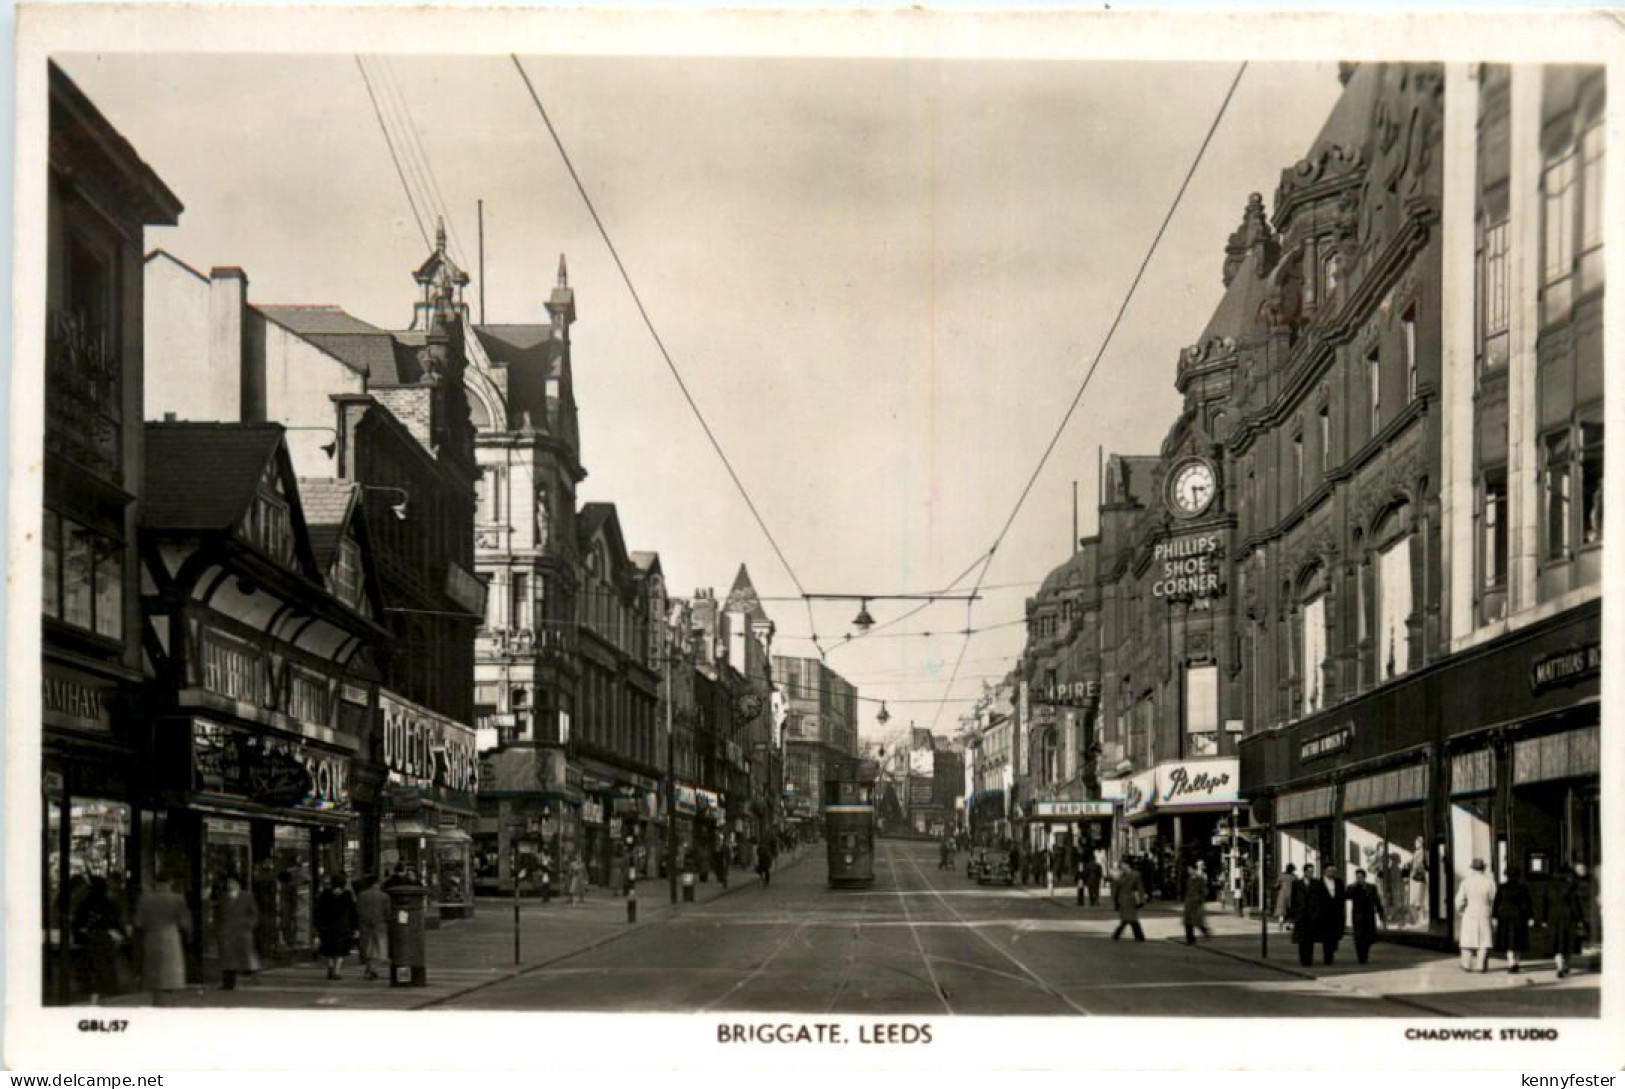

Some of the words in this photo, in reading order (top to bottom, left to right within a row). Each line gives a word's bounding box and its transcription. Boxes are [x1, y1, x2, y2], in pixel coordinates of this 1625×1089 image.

[1155, 535, 1217, 561] PHILLIPS
[1164, 555, 1208, 579] SHOE
[1152, 573, 1218, 598] CORNER
[1163, 765, 1230, 801] Phillips
[1051, 803, 1100, 814] EMPIRE
